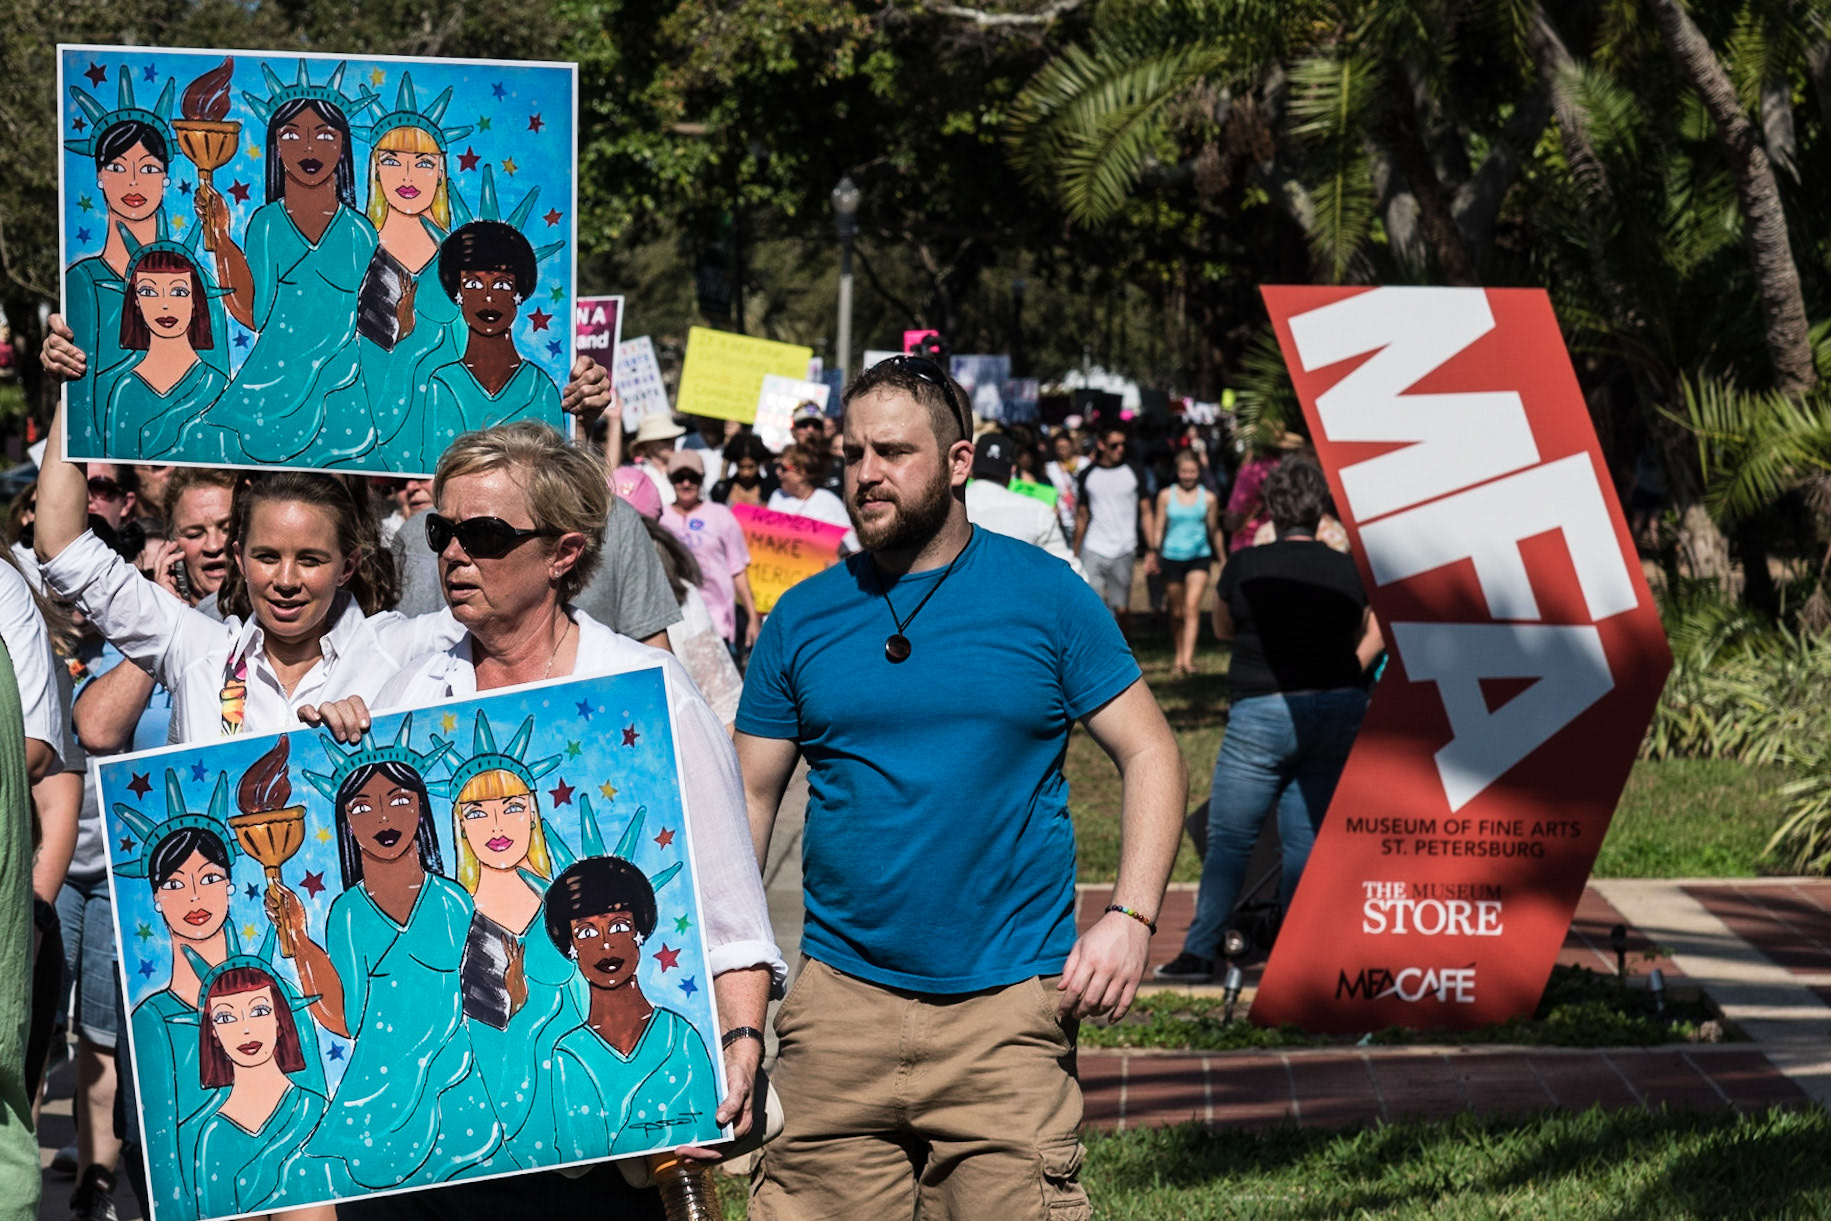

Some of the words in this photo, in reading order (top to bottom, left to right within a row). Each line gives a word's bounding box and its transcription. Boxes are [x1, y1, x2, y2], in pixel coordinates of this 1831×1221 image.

[748, 531, 803, 559] MAKE
[1288, 286, 1639, 813] MFA
[1345, 817, 1436, 834] MUSEUM
[1443, 819, 1473, 836] OF
[1478, 819, 1525, 837] FINE
[1530, 820, 1582, 838] ARTS
[1381, 838, 1408, 856] ST.
[1415, 840, 1546, 859] PETERSBURG
[1362, 881, 1407, 900] THE
[1412, 883, 1502, 901] MUSEUM
[1362, 898, 1503, 936] STORE
